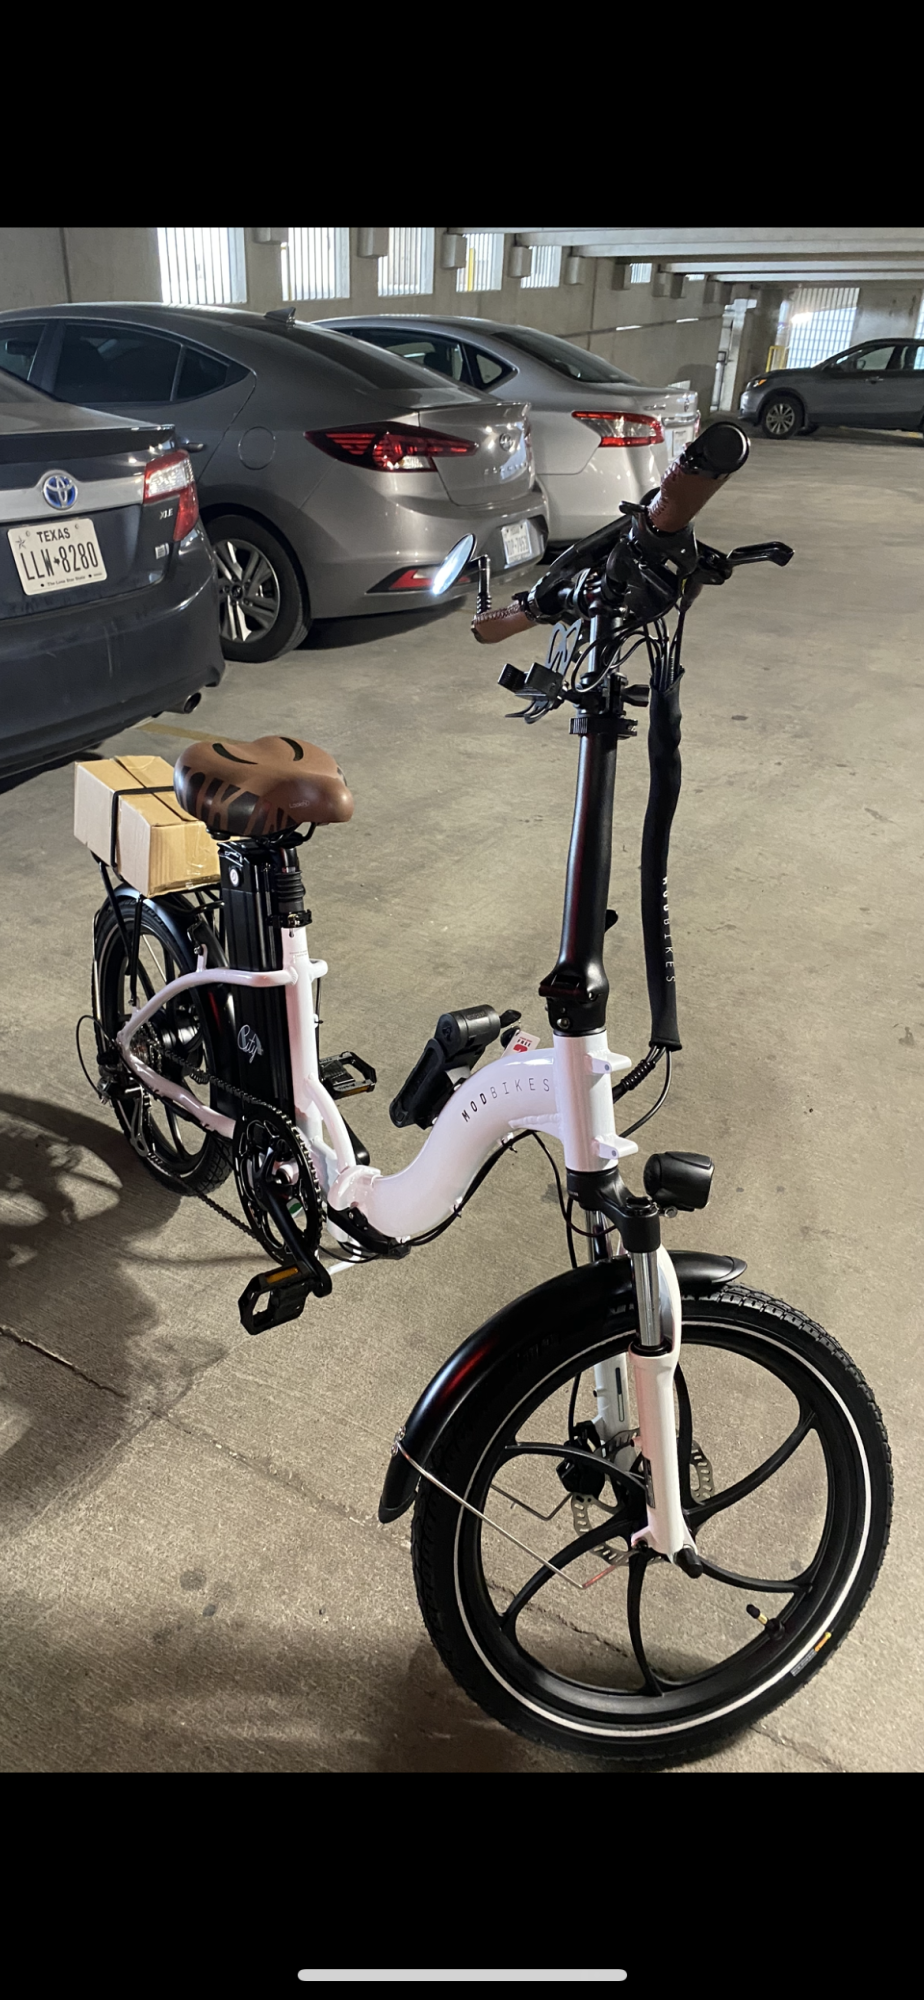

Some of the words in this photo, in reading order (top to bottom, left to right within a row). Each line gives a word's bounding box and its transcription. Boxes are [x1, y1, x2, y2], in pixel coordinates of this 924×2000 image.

[159, 508, 174, 520] XLE
[36, 527, 71, 543] TEXAS
[237, 1024, 260, 1064] City
[461, 1078, 550, 1123] MODBIKES
